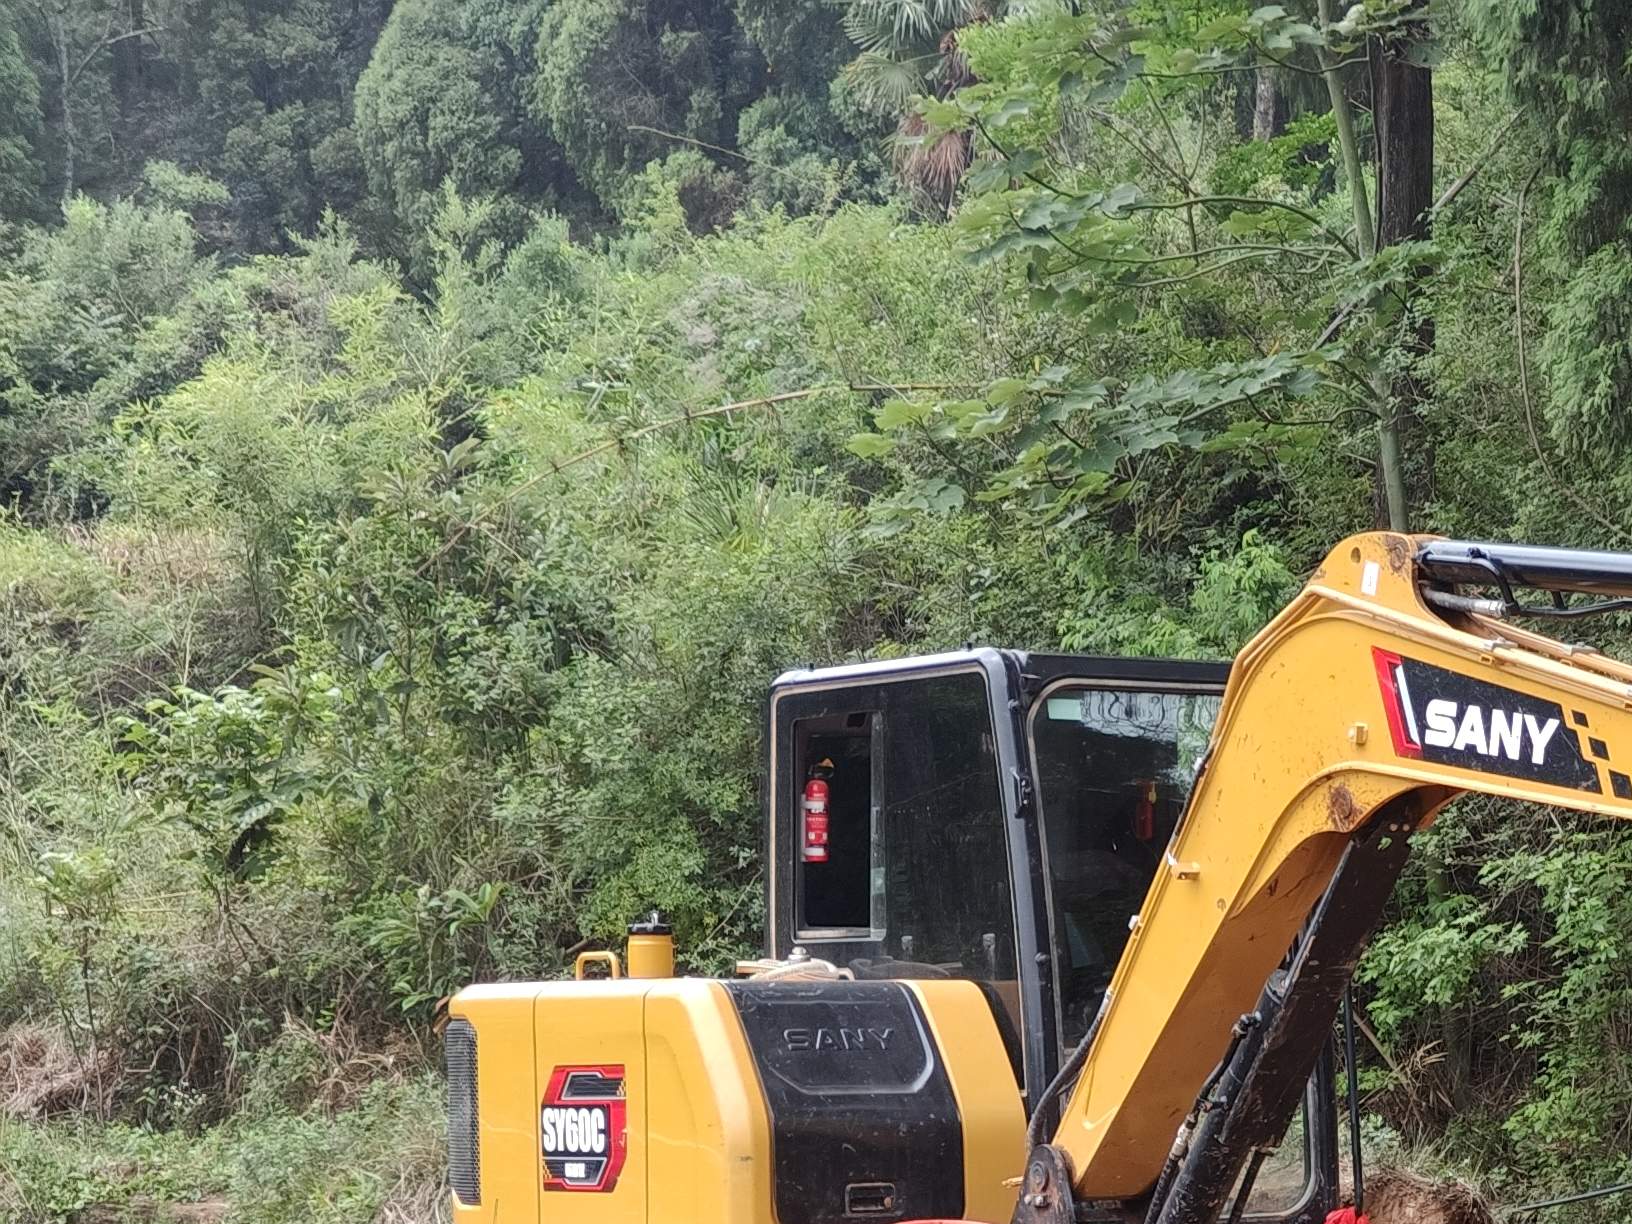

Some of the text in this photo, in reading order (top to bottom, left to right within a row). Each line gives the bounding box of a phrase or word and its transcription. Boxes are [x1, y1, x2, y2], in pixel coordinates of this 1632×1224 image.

[1424, 698, 1560, 766] SANY
[783, 1028, 894, 1051] SANY
[542, 1107, 605, 1154] SY60C
